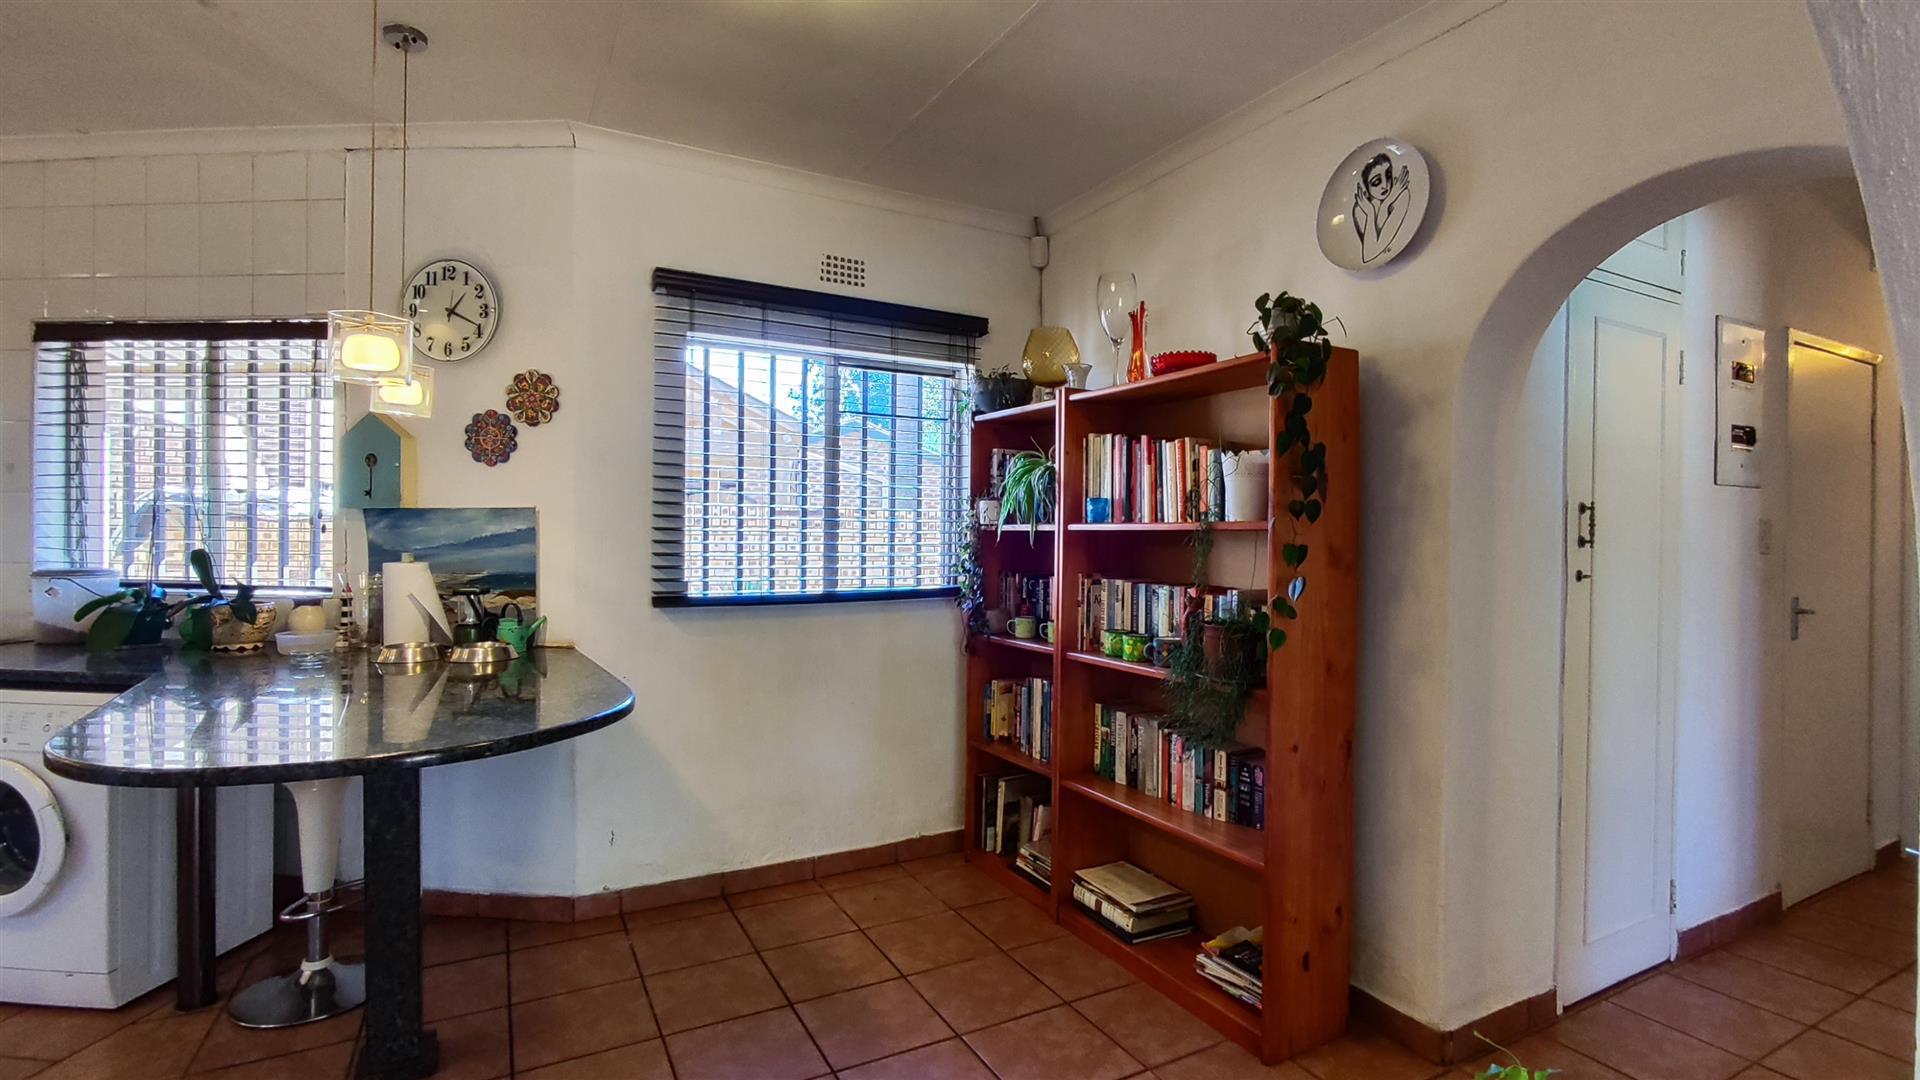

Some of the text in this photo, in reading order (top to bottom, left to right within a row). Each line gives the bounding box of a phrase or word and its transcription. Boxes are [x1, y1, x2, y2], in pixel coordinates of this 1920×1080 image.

[425, 271, 437, 286] 11
[441, 266, 456, 280] 12
[463, 271, 469, 286] 1
[412, 284, 426, 299] 10
[474, 284, 484, 299] 2
[409, 303, 417, 318] 9
[479, 303, 489, 318] 3
[413, 323, 421, 337] 8
[473, 323, 483, 339] 4
[426, 337, 434, 352] 7
[444, 342, 452, 357] 6
[461, 337, 470, 352] 5
